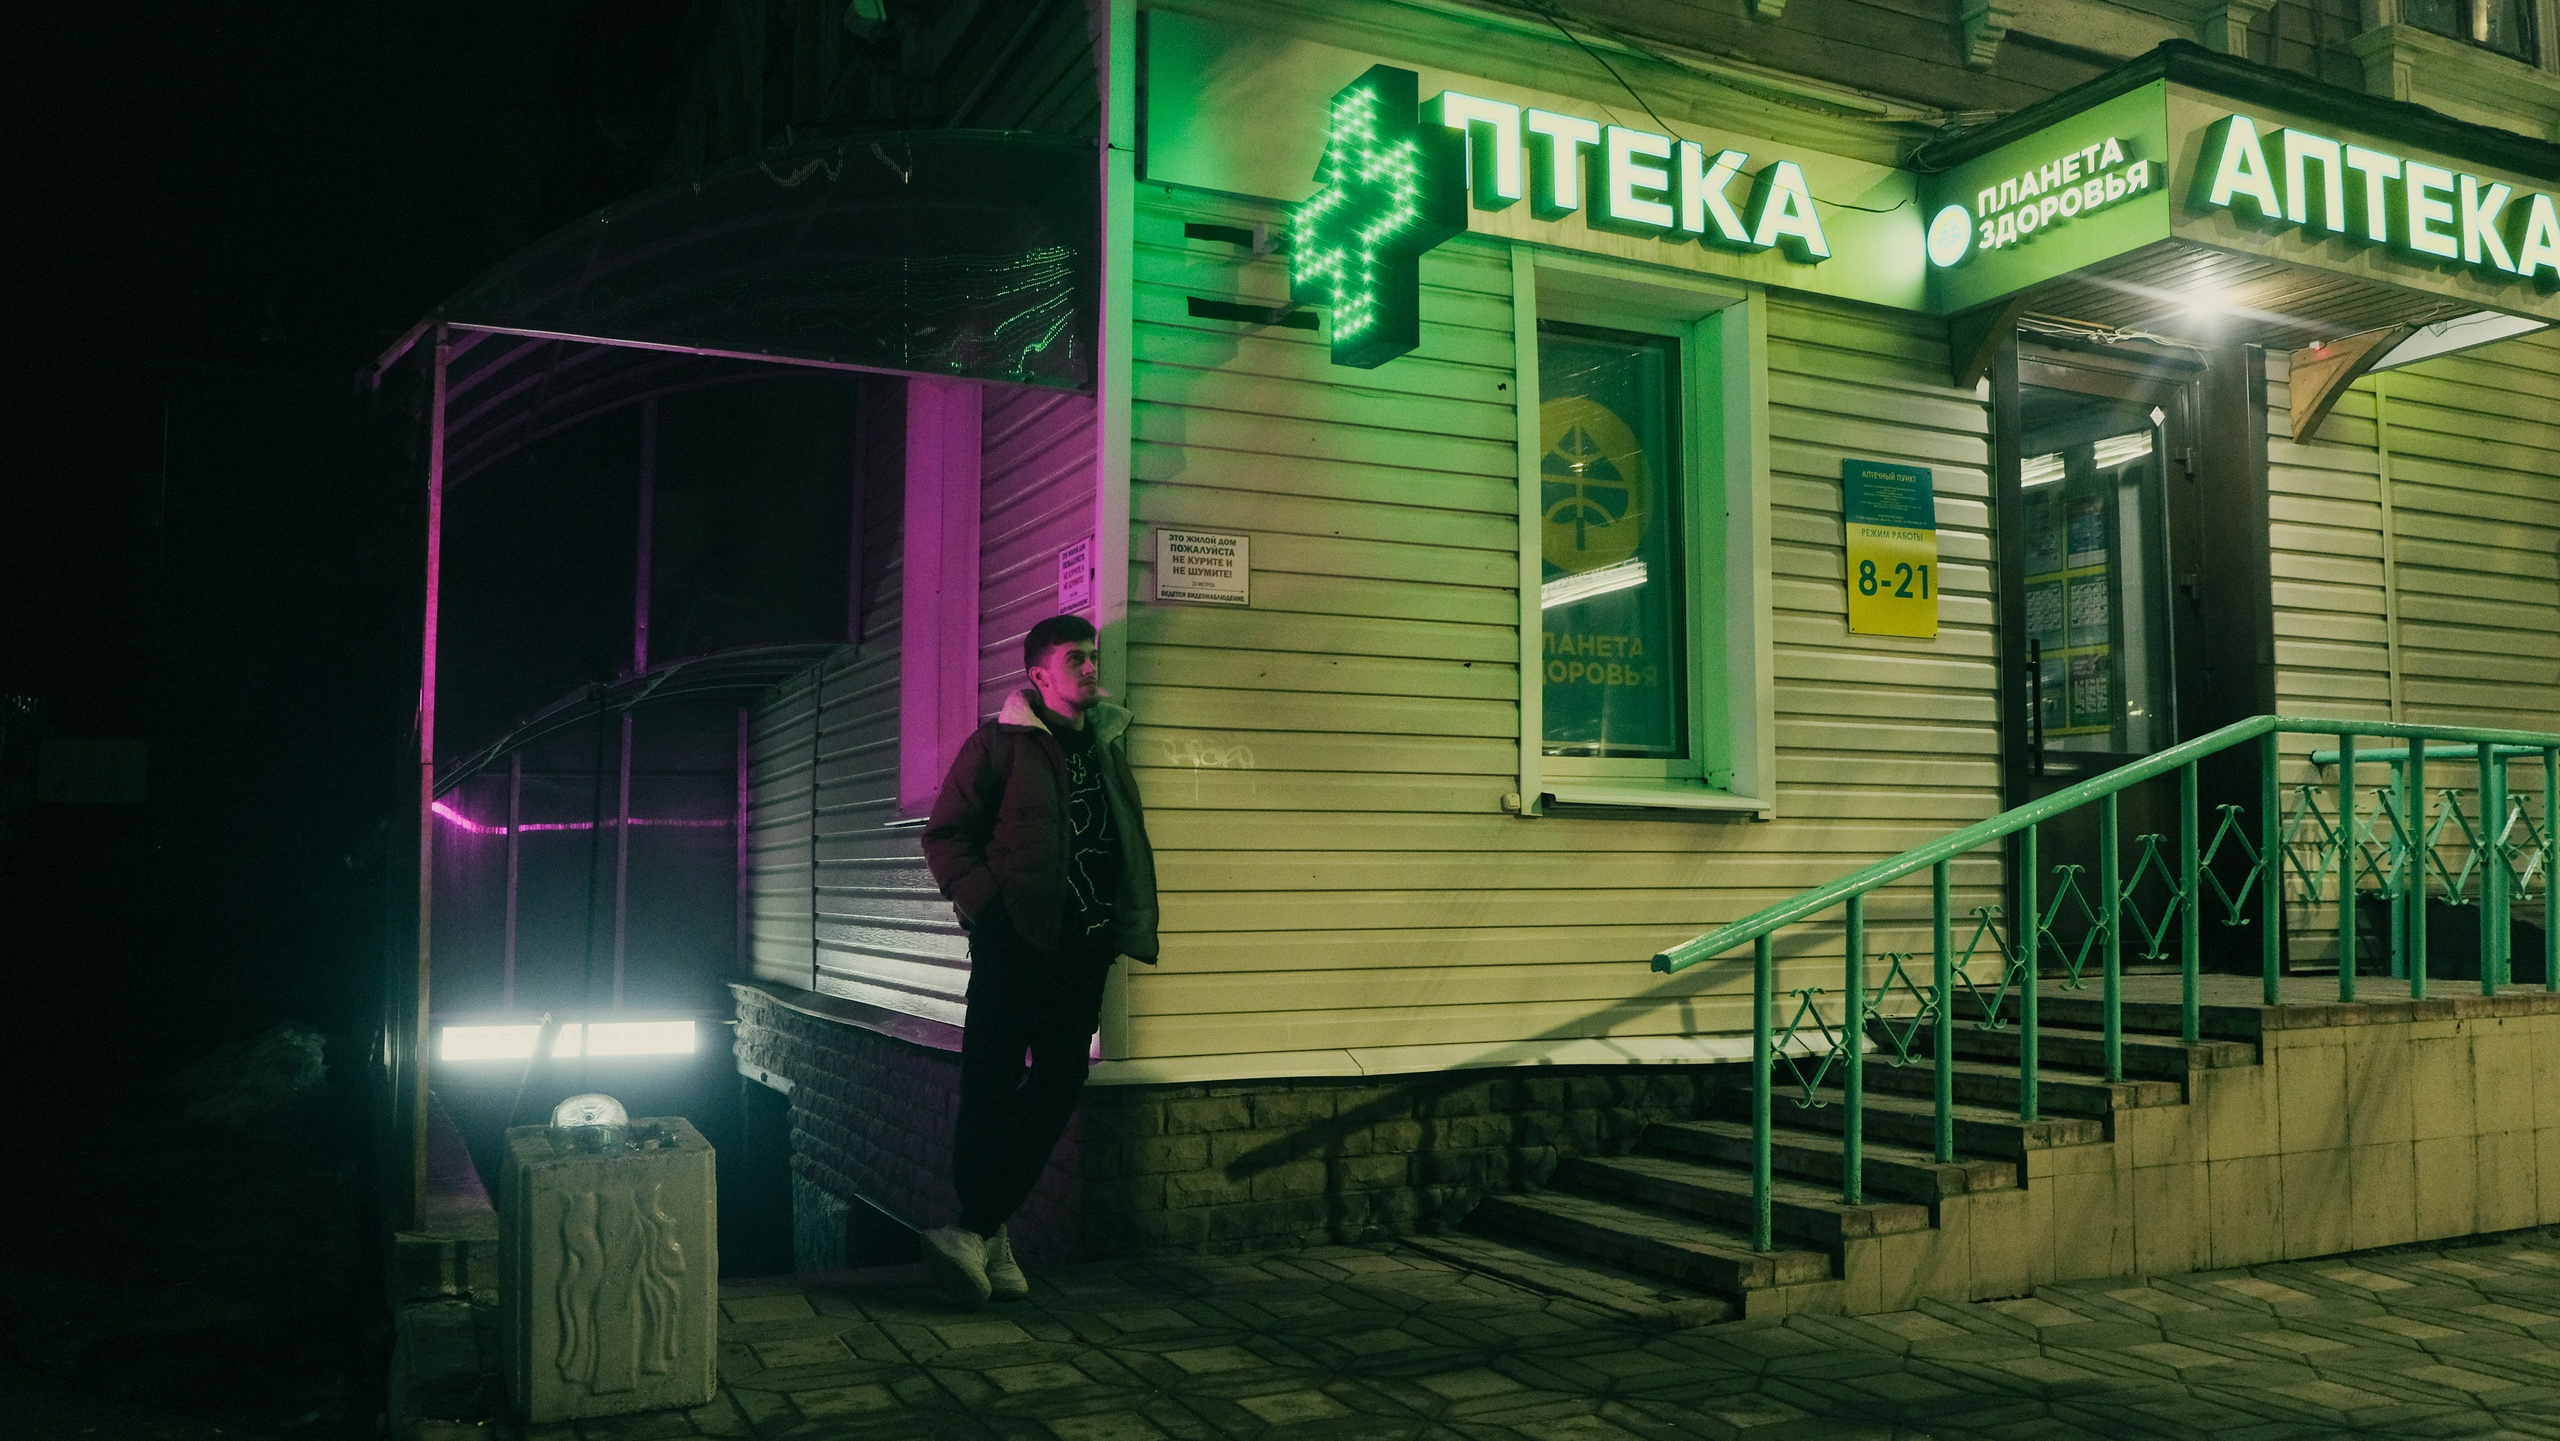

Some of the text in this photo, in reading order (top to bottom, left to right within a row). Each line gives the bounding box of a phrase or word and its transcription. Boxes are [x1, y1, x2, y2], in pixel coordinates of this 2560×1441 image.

[1440, 89, 1832, 264] ПТЕКА
[1977, 136, 2126, 215] ПЛАНЕТА
[2206, 112, 2560, 280] АПТЕКА
[1977, 159, 2150, 250] ЗДОРОВЬЯ
[1861, 470, 1917, 484] АПТЕЧНЫЙ ПУНКТ
[1186, 535, 1217, 544] ЖИЛОЙ
[1861, 528, 1924, 542] РЕЖИМ РАБОТЫ
[1170, 543, 1235, 557] ПОЖАЛУЙСТА
[1172, 555, 1233, 567] НЕ КУРИТЕ И
[1173, 567, 1233, 578] НЕ ШУМИТЕ!
[1858, 559, 1929, 600] 8-21
[1161, 590, 1244, 602] ВЕДЕТСЯ ВИДЕОНАБЛЮДЕНИЕ
[1542, 631, 1645, 659] ЛАНЕТА
